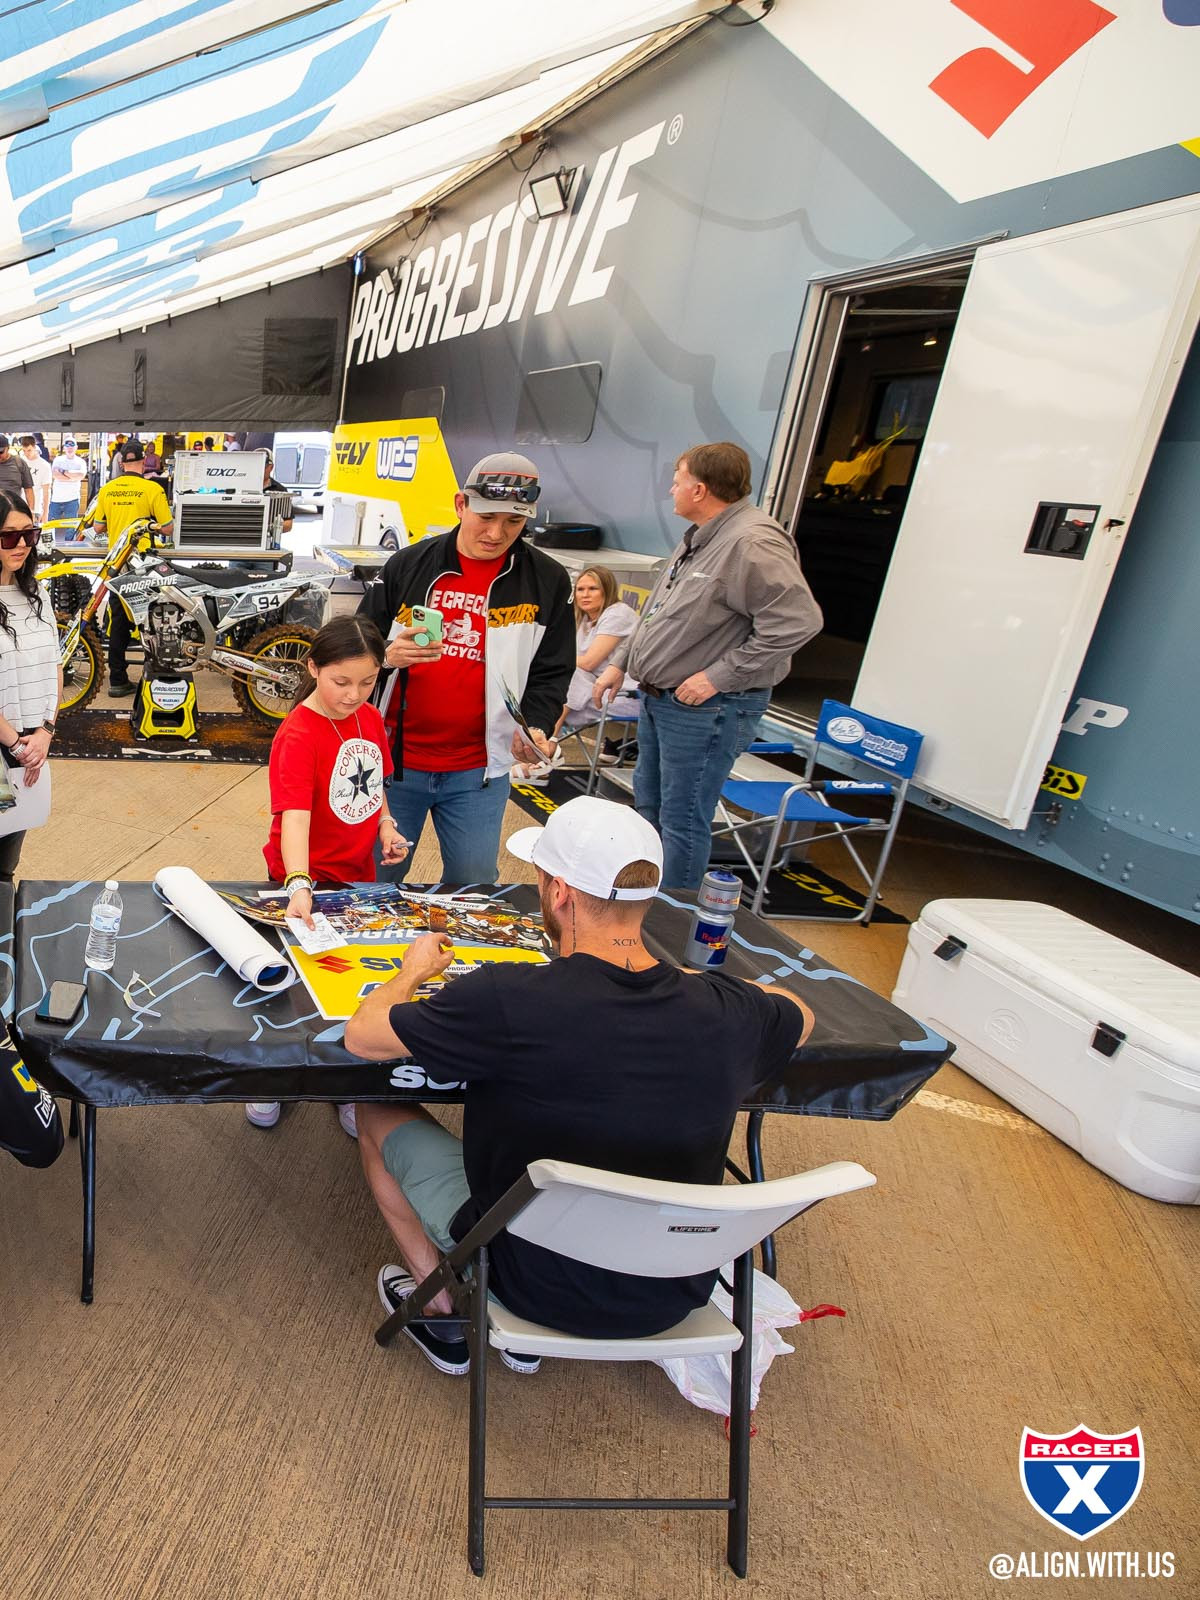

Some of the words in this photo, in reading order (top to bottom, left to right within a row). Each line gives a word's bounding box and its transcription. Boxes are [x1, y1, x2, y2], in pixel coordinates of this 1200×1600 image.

[346, 120, 666, 368] PROGRESSIVE
[376, 434, 420, 482] WPS
[106, 490, 144, 498] PROGRESSIVE
[119, 575, 178, 595] PROGRESSIVE
[258, 594, 281, 610] 94
[339, 744, 381, 777] CONVERSE
[341, 803, 356, 817] ALL
[357, 793, 381, 817] STAR
[612, 938, 639, 946] XCIV
